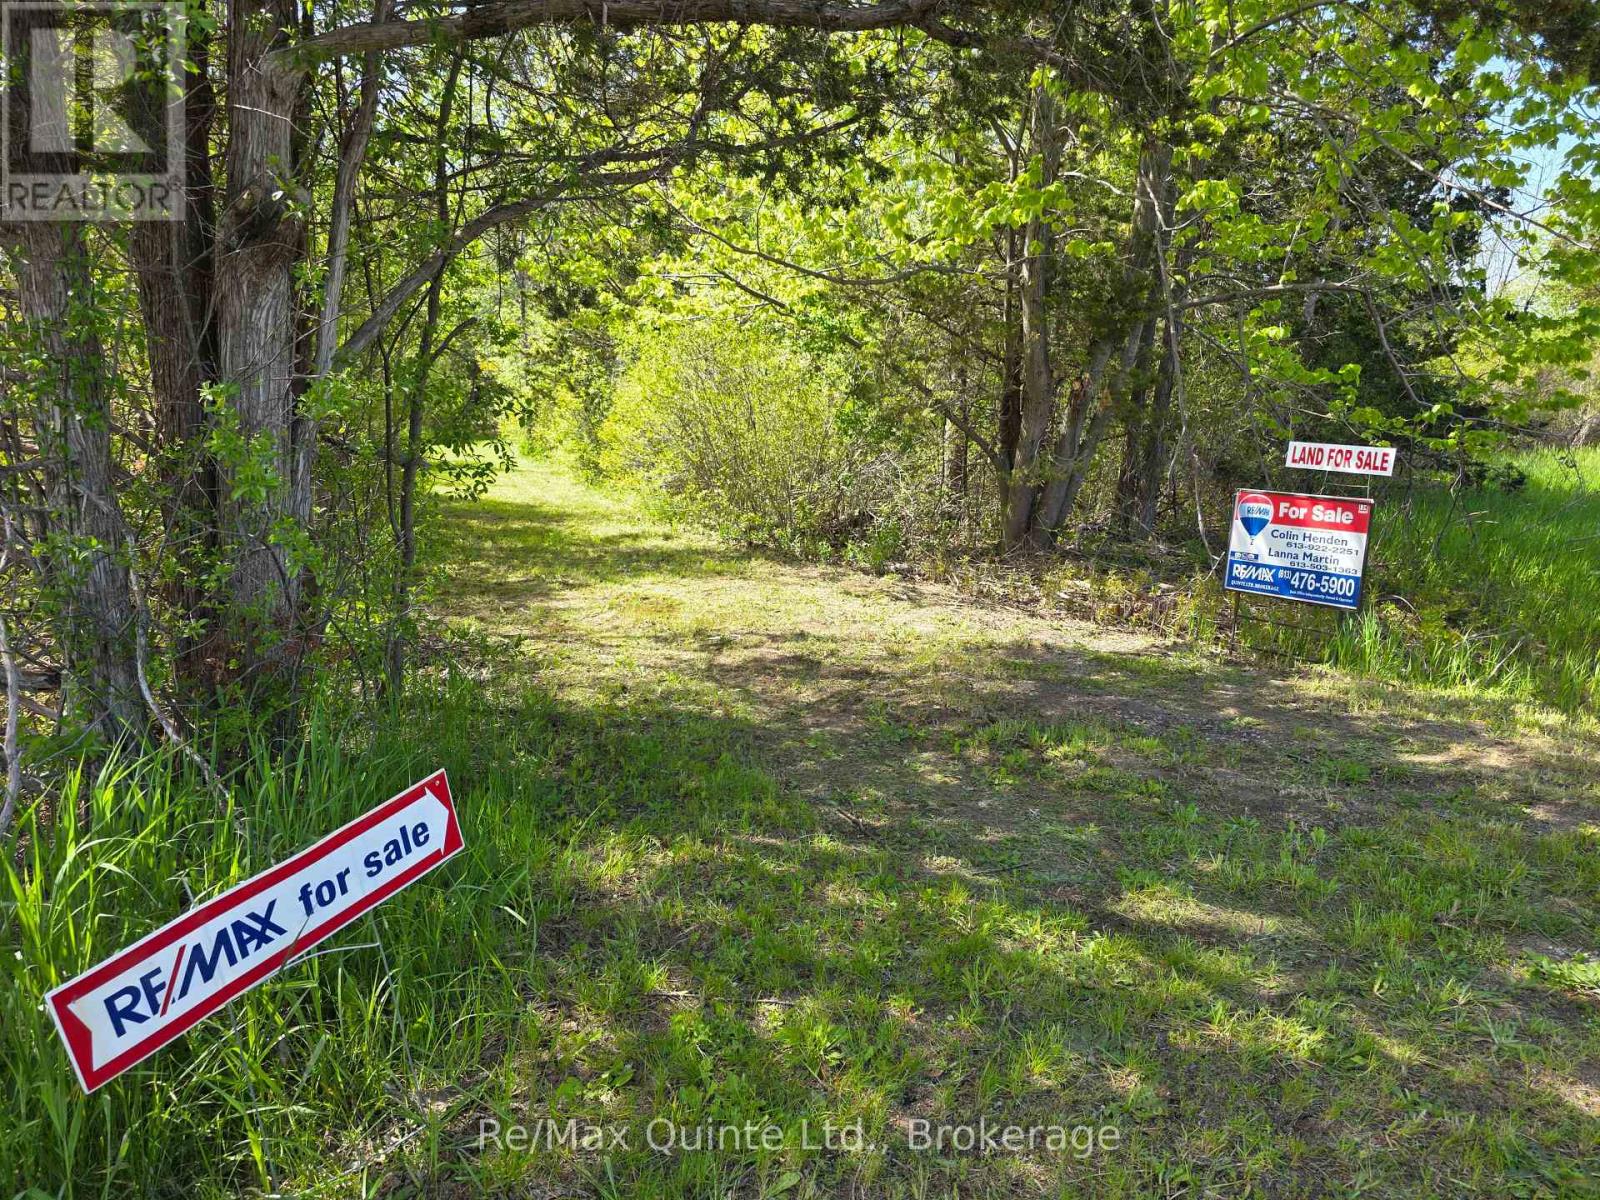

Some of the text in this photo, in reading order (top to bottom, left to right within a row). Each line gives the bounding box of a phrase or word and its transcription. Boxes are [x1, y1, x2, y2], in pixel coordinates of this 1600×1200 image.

[1291, 446, 1389, 472] LAND FOR SALE
[1278, 502, 1308, 520] For
[1311, 504, 1354, 525] Sale
[1270, 529, 1299, 542] Colin
[1302, 533, 1348, 547] Henden
[1286, 541, 1359, 556] 613-922-2251
[1268, 547, 1299, 560] Lanna
[1302, 552, 1340, 566] Martin
[1232, 563, 1276, 583] RE/MAX
[1290, 572, 1354, 597] 476-5900
[103, 821, 431, 1038] RE/MAX for sale
